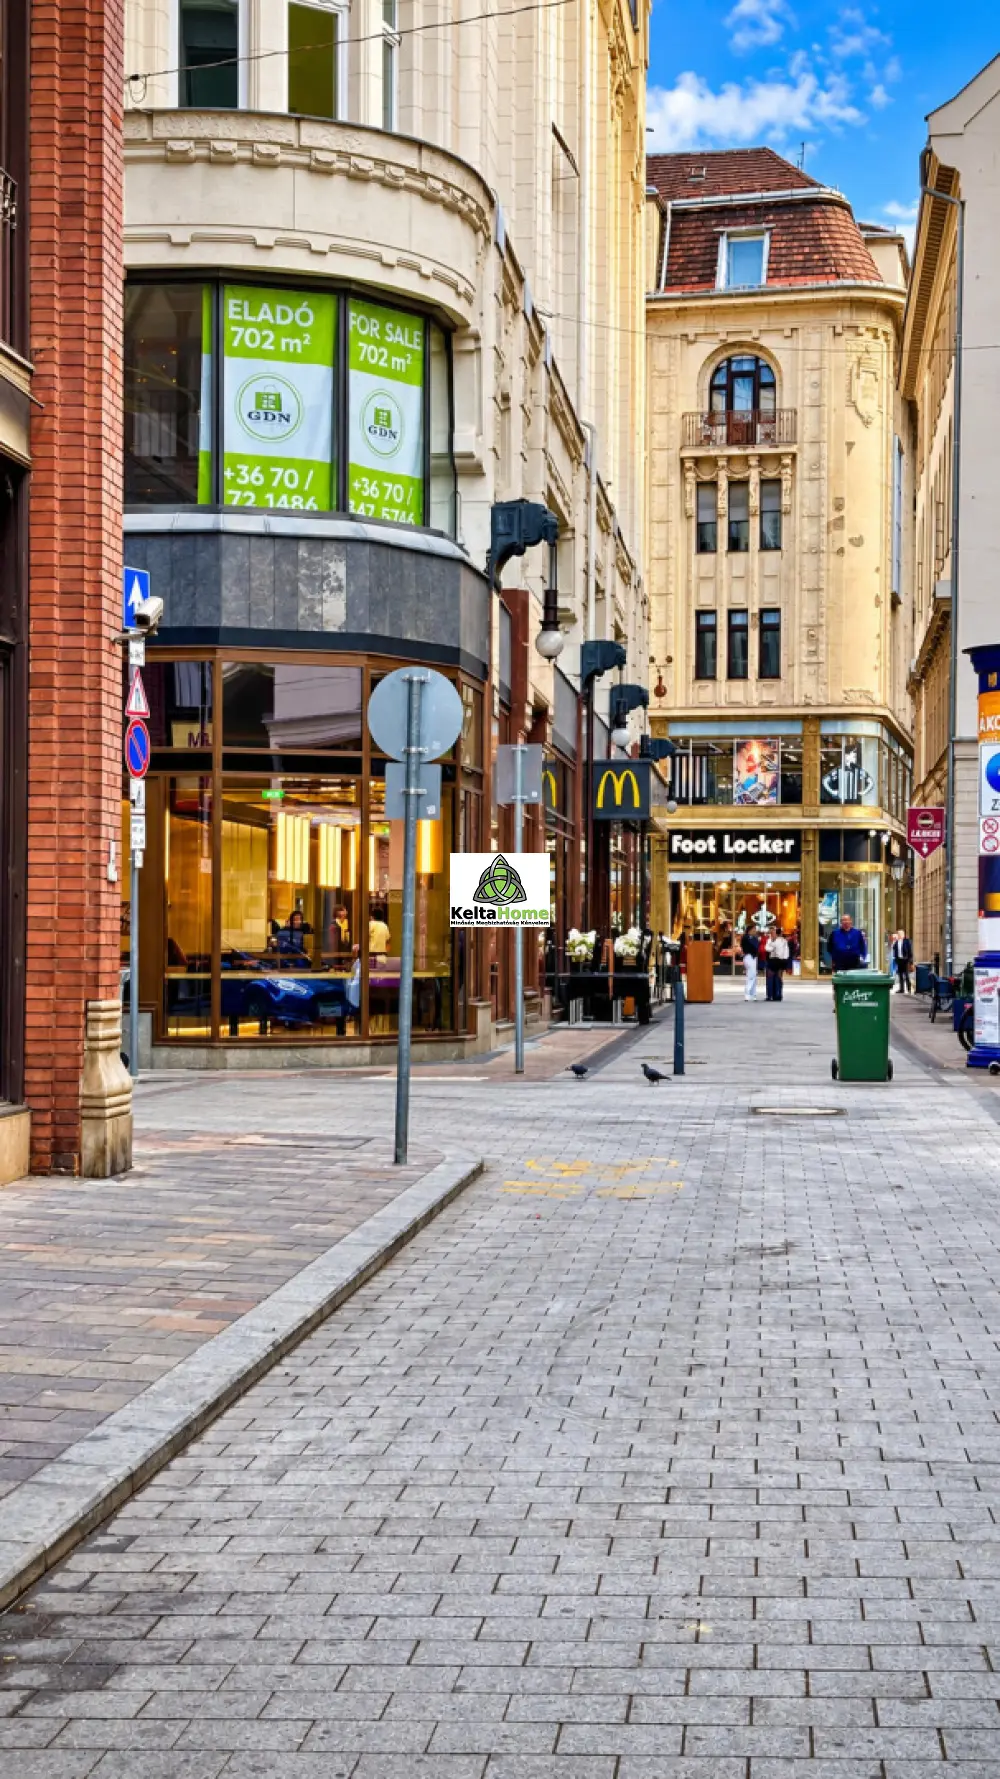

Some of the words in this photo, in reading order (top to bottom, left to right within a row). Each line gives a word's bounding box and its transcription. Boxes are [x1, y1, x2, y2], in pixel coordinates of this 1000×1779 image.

[228, 299, 314, 327] ELADÓ
[231, 327, 275, 350] 702
[349, 312, 380, 340] FOR
[385, 322, 421, 352] SALE
[358, 342, 388, 367] 702
[247, 411, 291, 423] GDN
[368, 424, 398, 440] GDN
[224, 464, 265, 486] +36
[270, 467, 299, 489] 70
[303, 469, 314, 491] /
[353, 477, 380, 499] +36
[383, 482, 404, 503] 70
[671, 834, 716, 853] Foot
[724, 834, 795, 853] Locker
